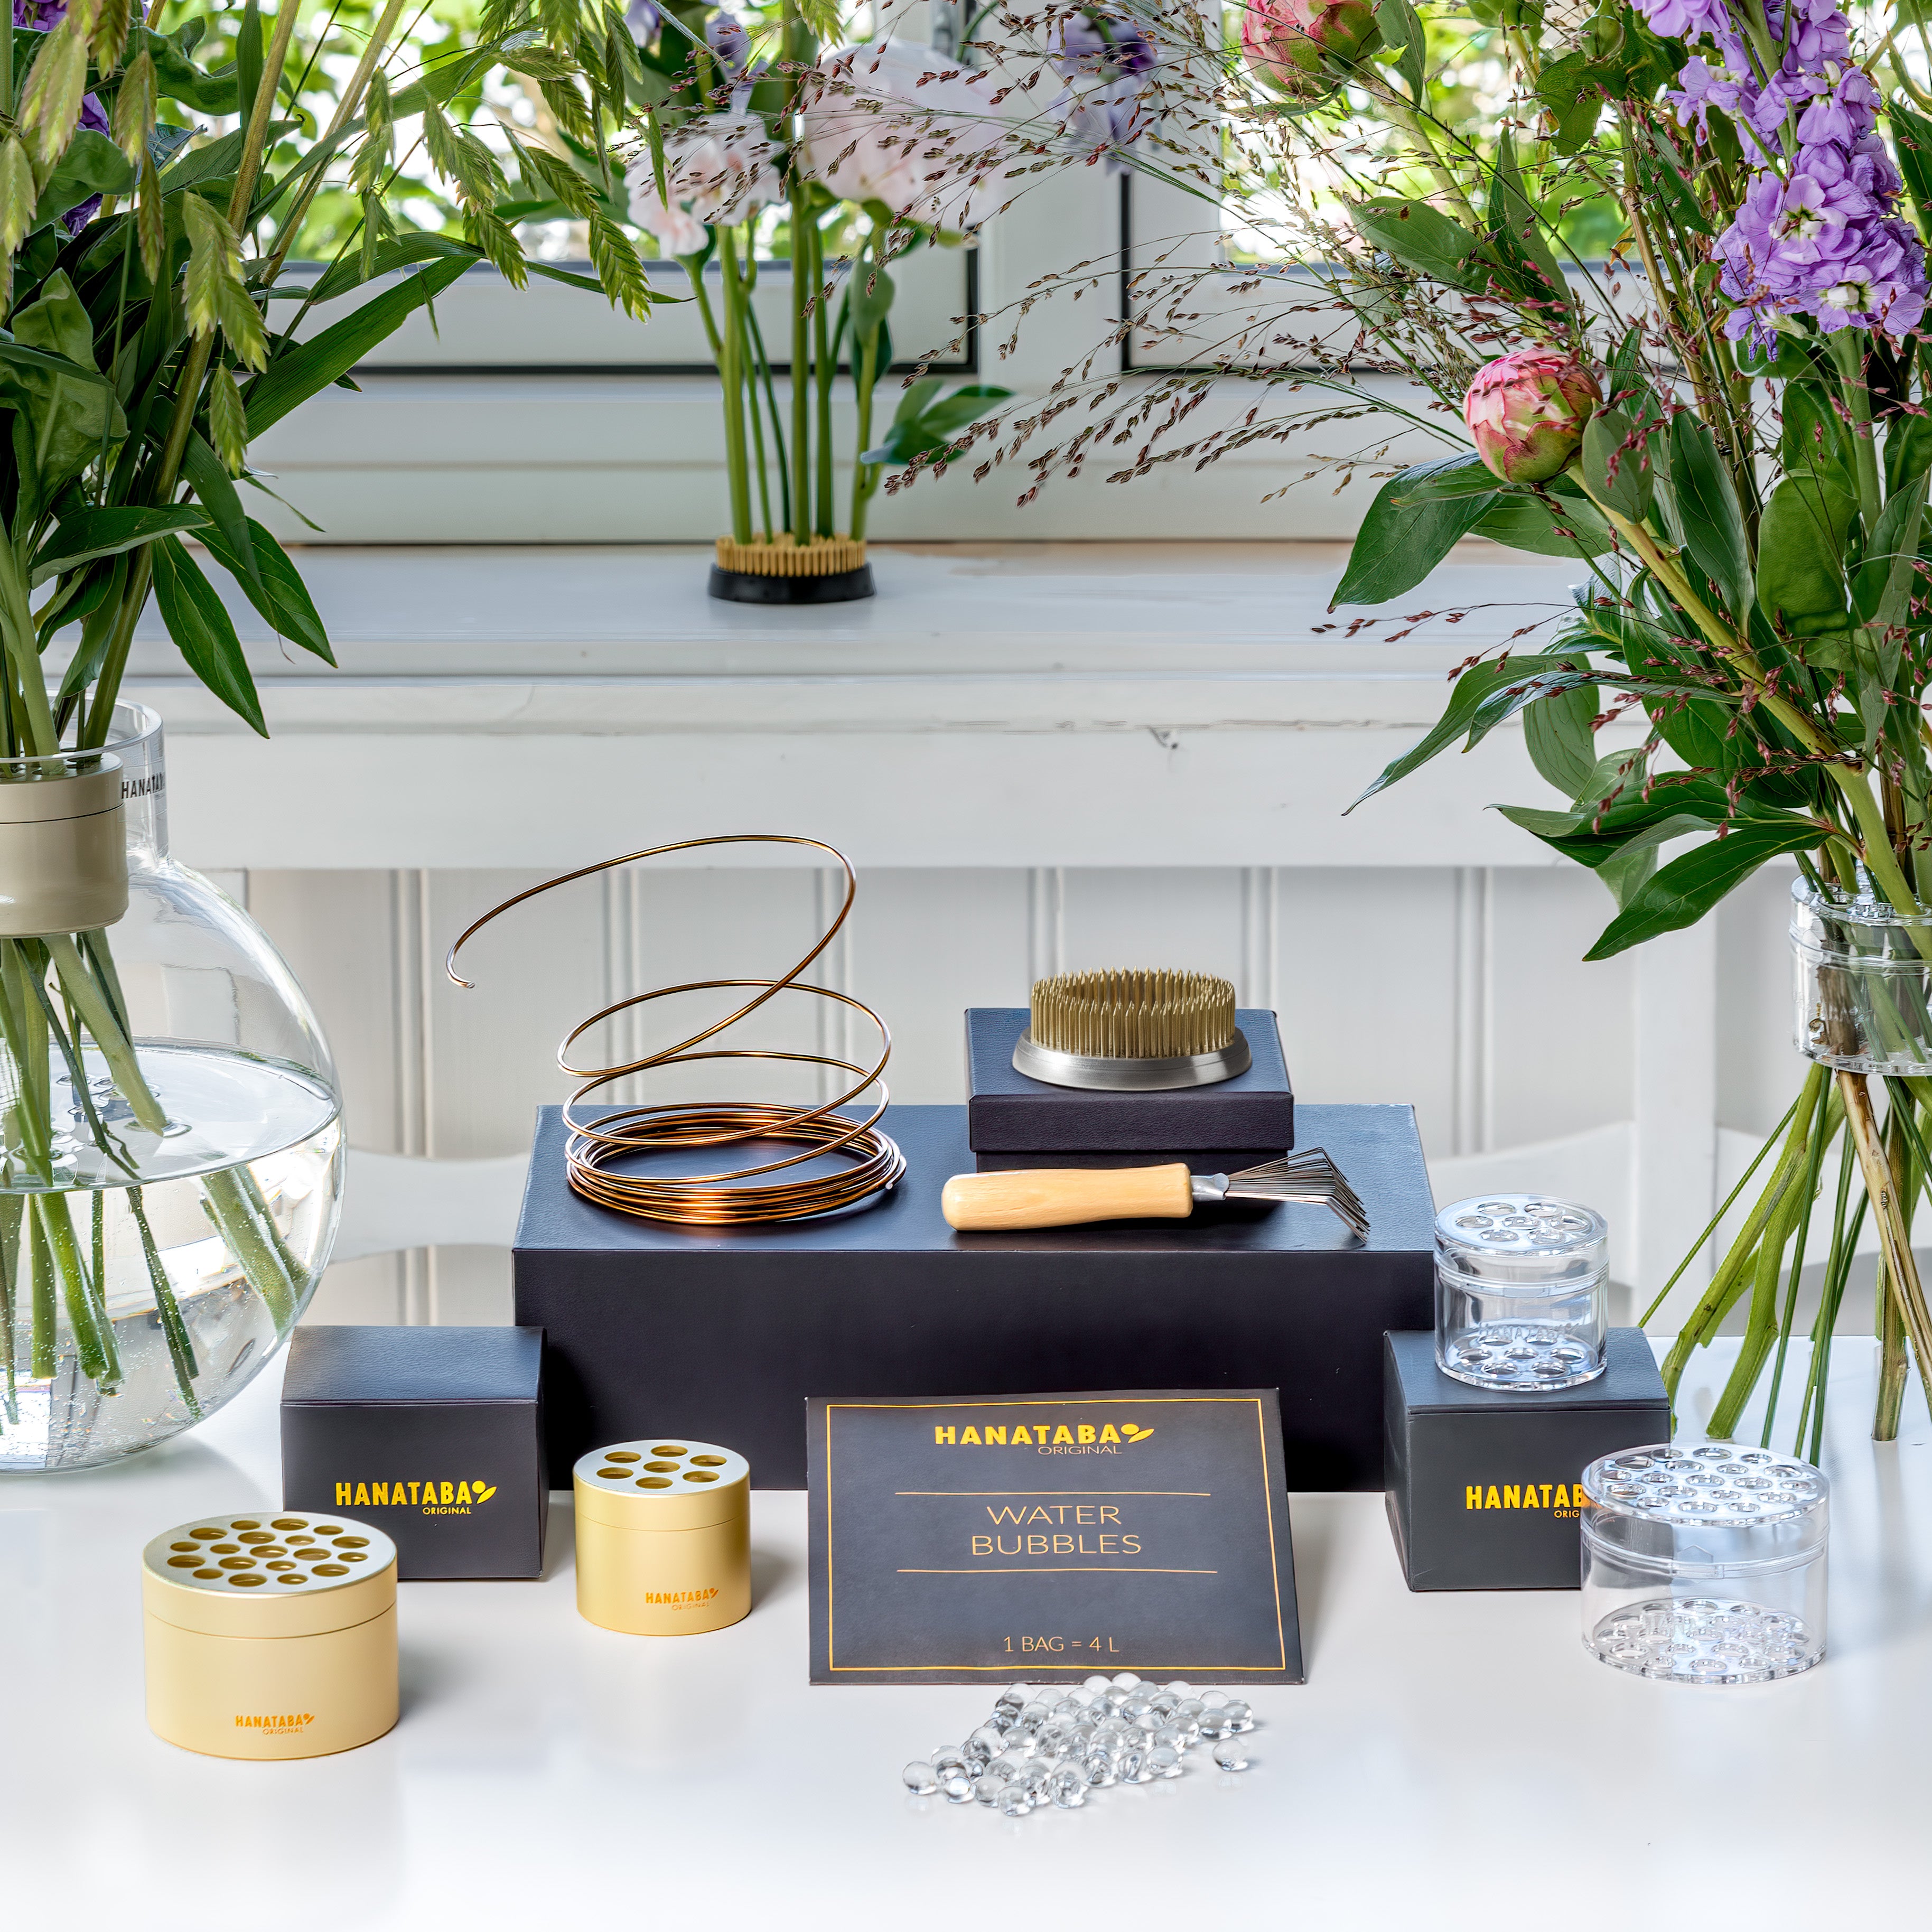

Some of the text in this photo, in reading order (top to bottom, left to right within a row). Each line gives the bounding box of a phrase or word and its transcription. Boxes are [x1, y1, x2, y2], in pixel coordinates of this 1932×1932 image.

[935, 1424, 1121, 1445] HANATABA
[1038, 1446, 1122, 1455] ORIGINAL
[335, 1481, 472, 1506] HANATABA
[1466, 1484, 1585, 1509] HANATAB
[423, 1507, 471, 1515] ORIGINAL
[987, 1506, 1122, 1525] WATER
[972, 1534, 1141, 1555] BUBBLES
[646, 1589, 709, 1604] HANATABA
[1004, 1636, 1014, 1652] 1
[1022, 1636, 1064, 1652] BAG
[1089, 1637, 1102, 1652] 4
[1109, 1637, 1120, 1653] L
[236, 1714, 303, 1728] HANATABA
